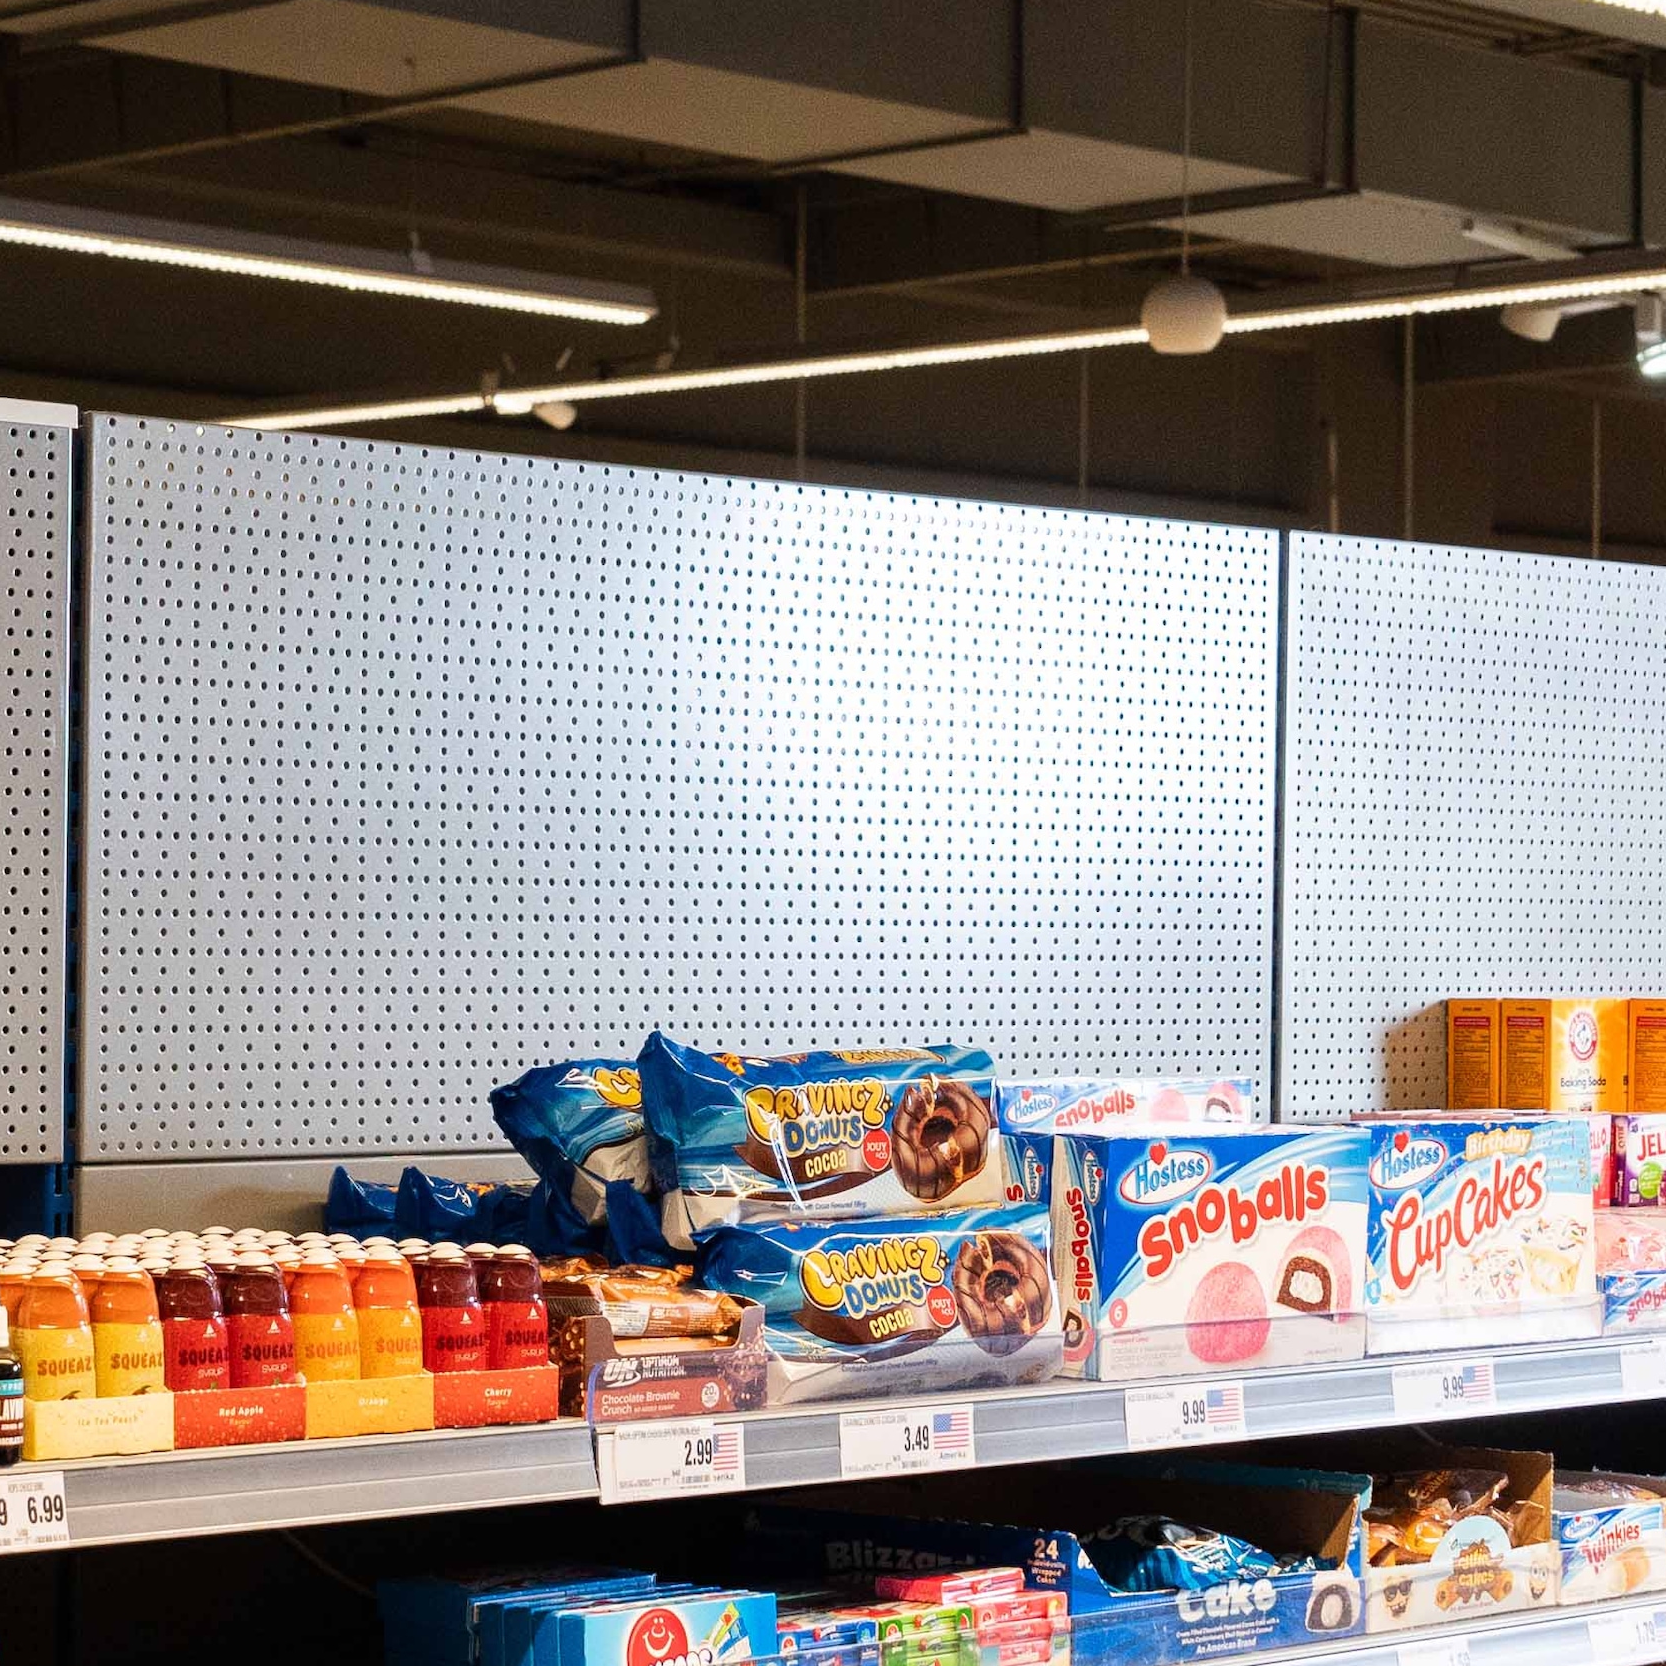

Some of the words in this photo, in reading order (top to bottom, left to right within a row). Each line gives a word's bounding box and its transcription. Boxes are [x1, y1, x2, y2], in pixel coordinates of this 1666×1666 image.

[784, 1112, 864, 1153] DONUTS
[1465, 1129, 1531, 1159] Birthday
[1135, 1151, 1207, 1198] Hostess
[1379, 1142, 1441, 1182] Hostess
[802, 1237, 942, 1309] CRAVINGZ
[845, 1273, 925, 1319] DONUTS
[219, 1406, 241, 1417] Red
[242, 1404, 265, 1419] Apple
[484, 1387, 514, 1399] Cherry
[1034, 1539, 1060, 1560] 24
